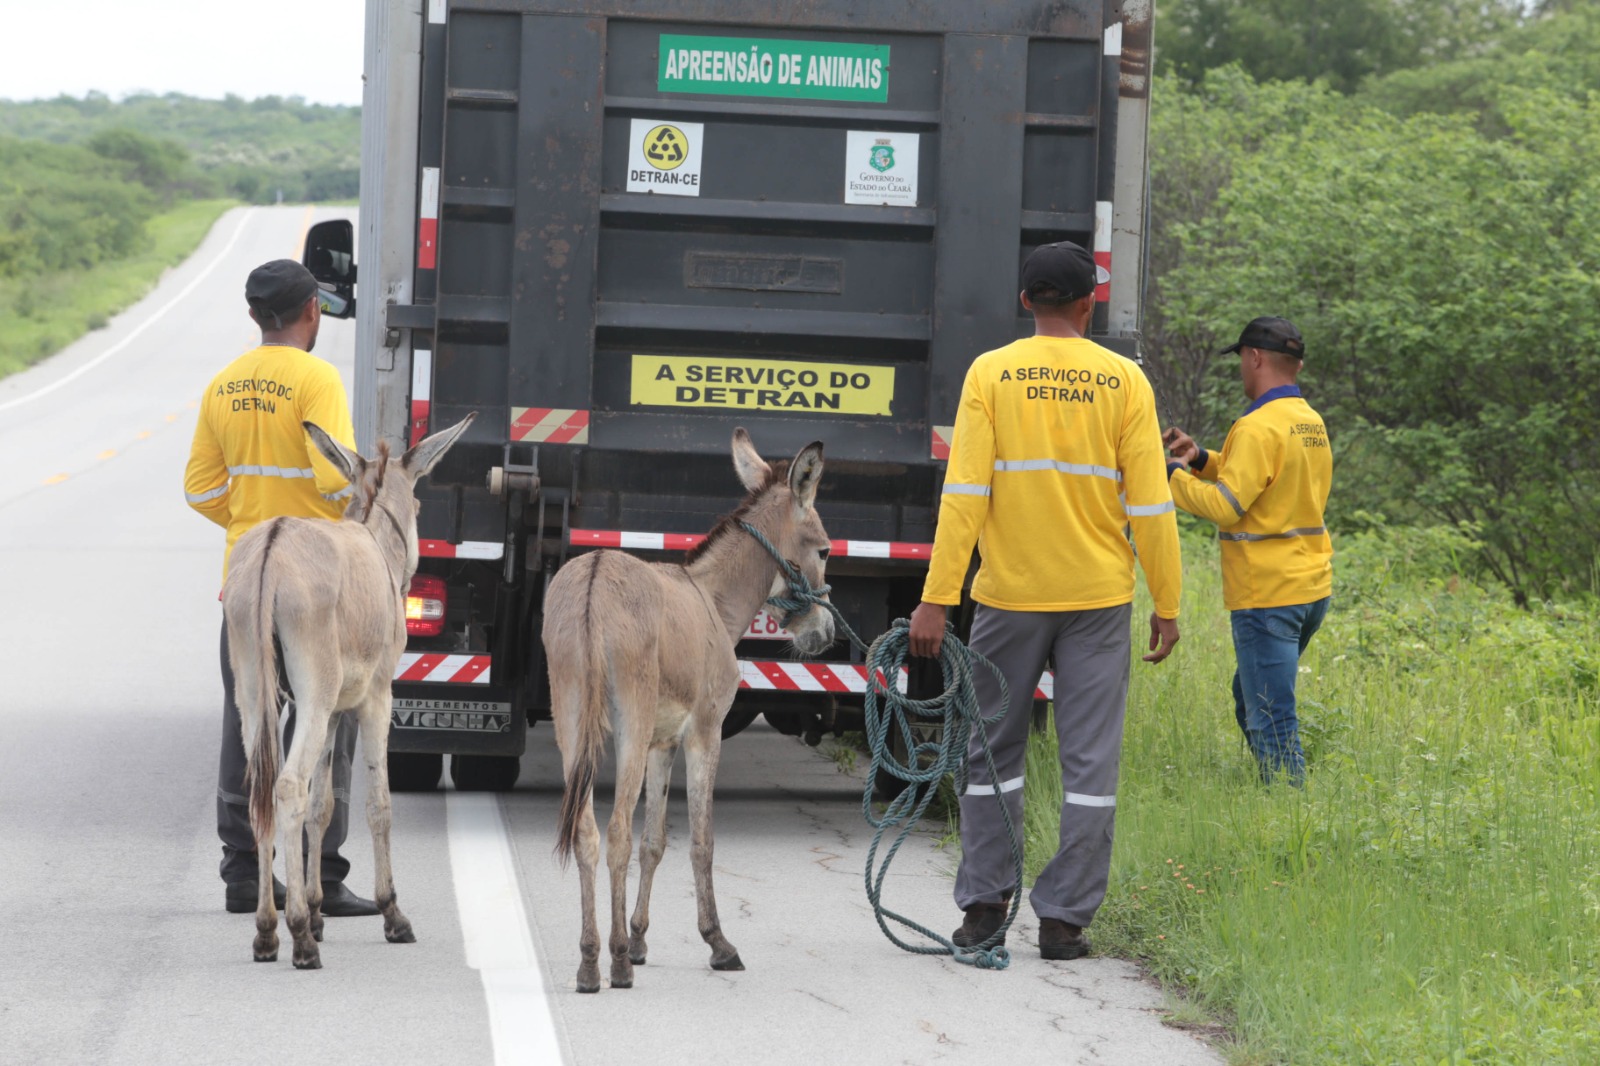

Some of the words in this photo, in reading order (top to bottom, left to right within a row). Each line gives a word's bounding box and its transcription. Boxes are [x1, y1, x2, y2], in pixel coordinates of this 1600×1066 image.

[665, 45, 773, 85] APREENSÃO
[778, 53, 802, 85] DE
[805, 55, 882, 89] ANIMAIS
[631, 170, 698, 186] DETRAN-CE
[655, 364, 676, 381] A
[685, 365, 819, 391] SERVIÇO
[830, 371, 871, 390] DO
[1000, 369, 1012, 382] A
[1016, 367, 1092, 385] SERVIÇO
[1096, 373, 1120, 389] DO
[216, 384, 225, 397] A
[675, 386, 841, 409] DETRAN
[1027, 386, 1095, 403] DETRAN
[232, 397, 276, 414] DETRAN
[399, 700, 498, 711] IMPLEMENTOS
